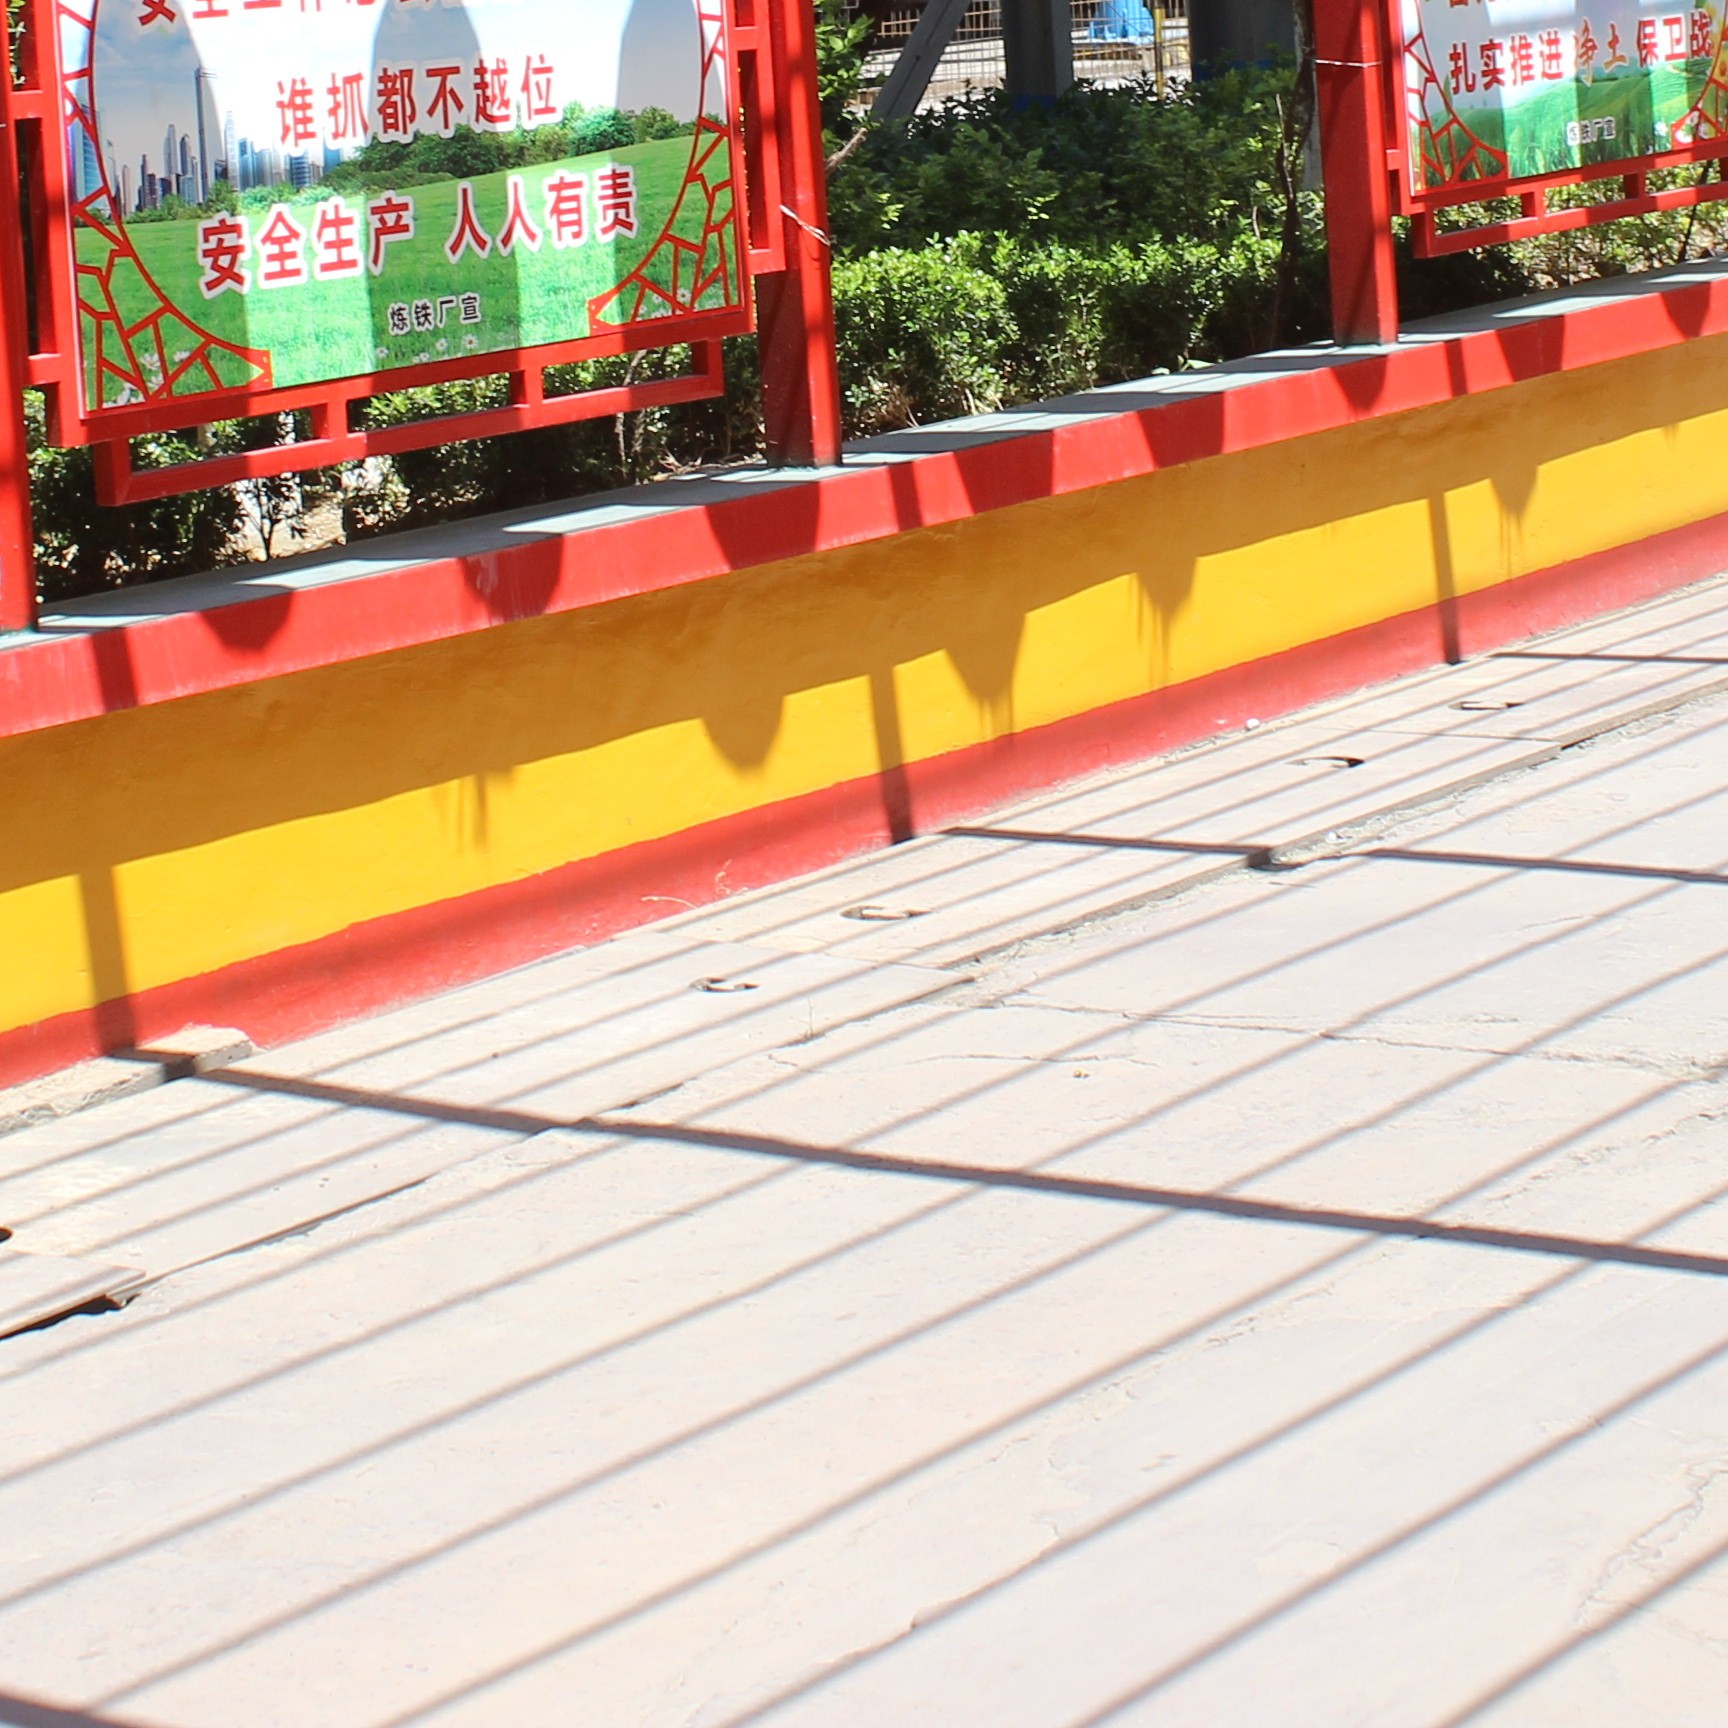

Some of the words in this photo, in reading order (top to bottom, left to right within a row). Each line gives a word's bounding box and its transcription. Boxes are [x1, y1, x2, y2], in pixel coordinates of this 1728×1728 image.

[276, 53, 558, 149] 谁抓都不越位
[389, 295, 480, 332] 炼铁厂宣
